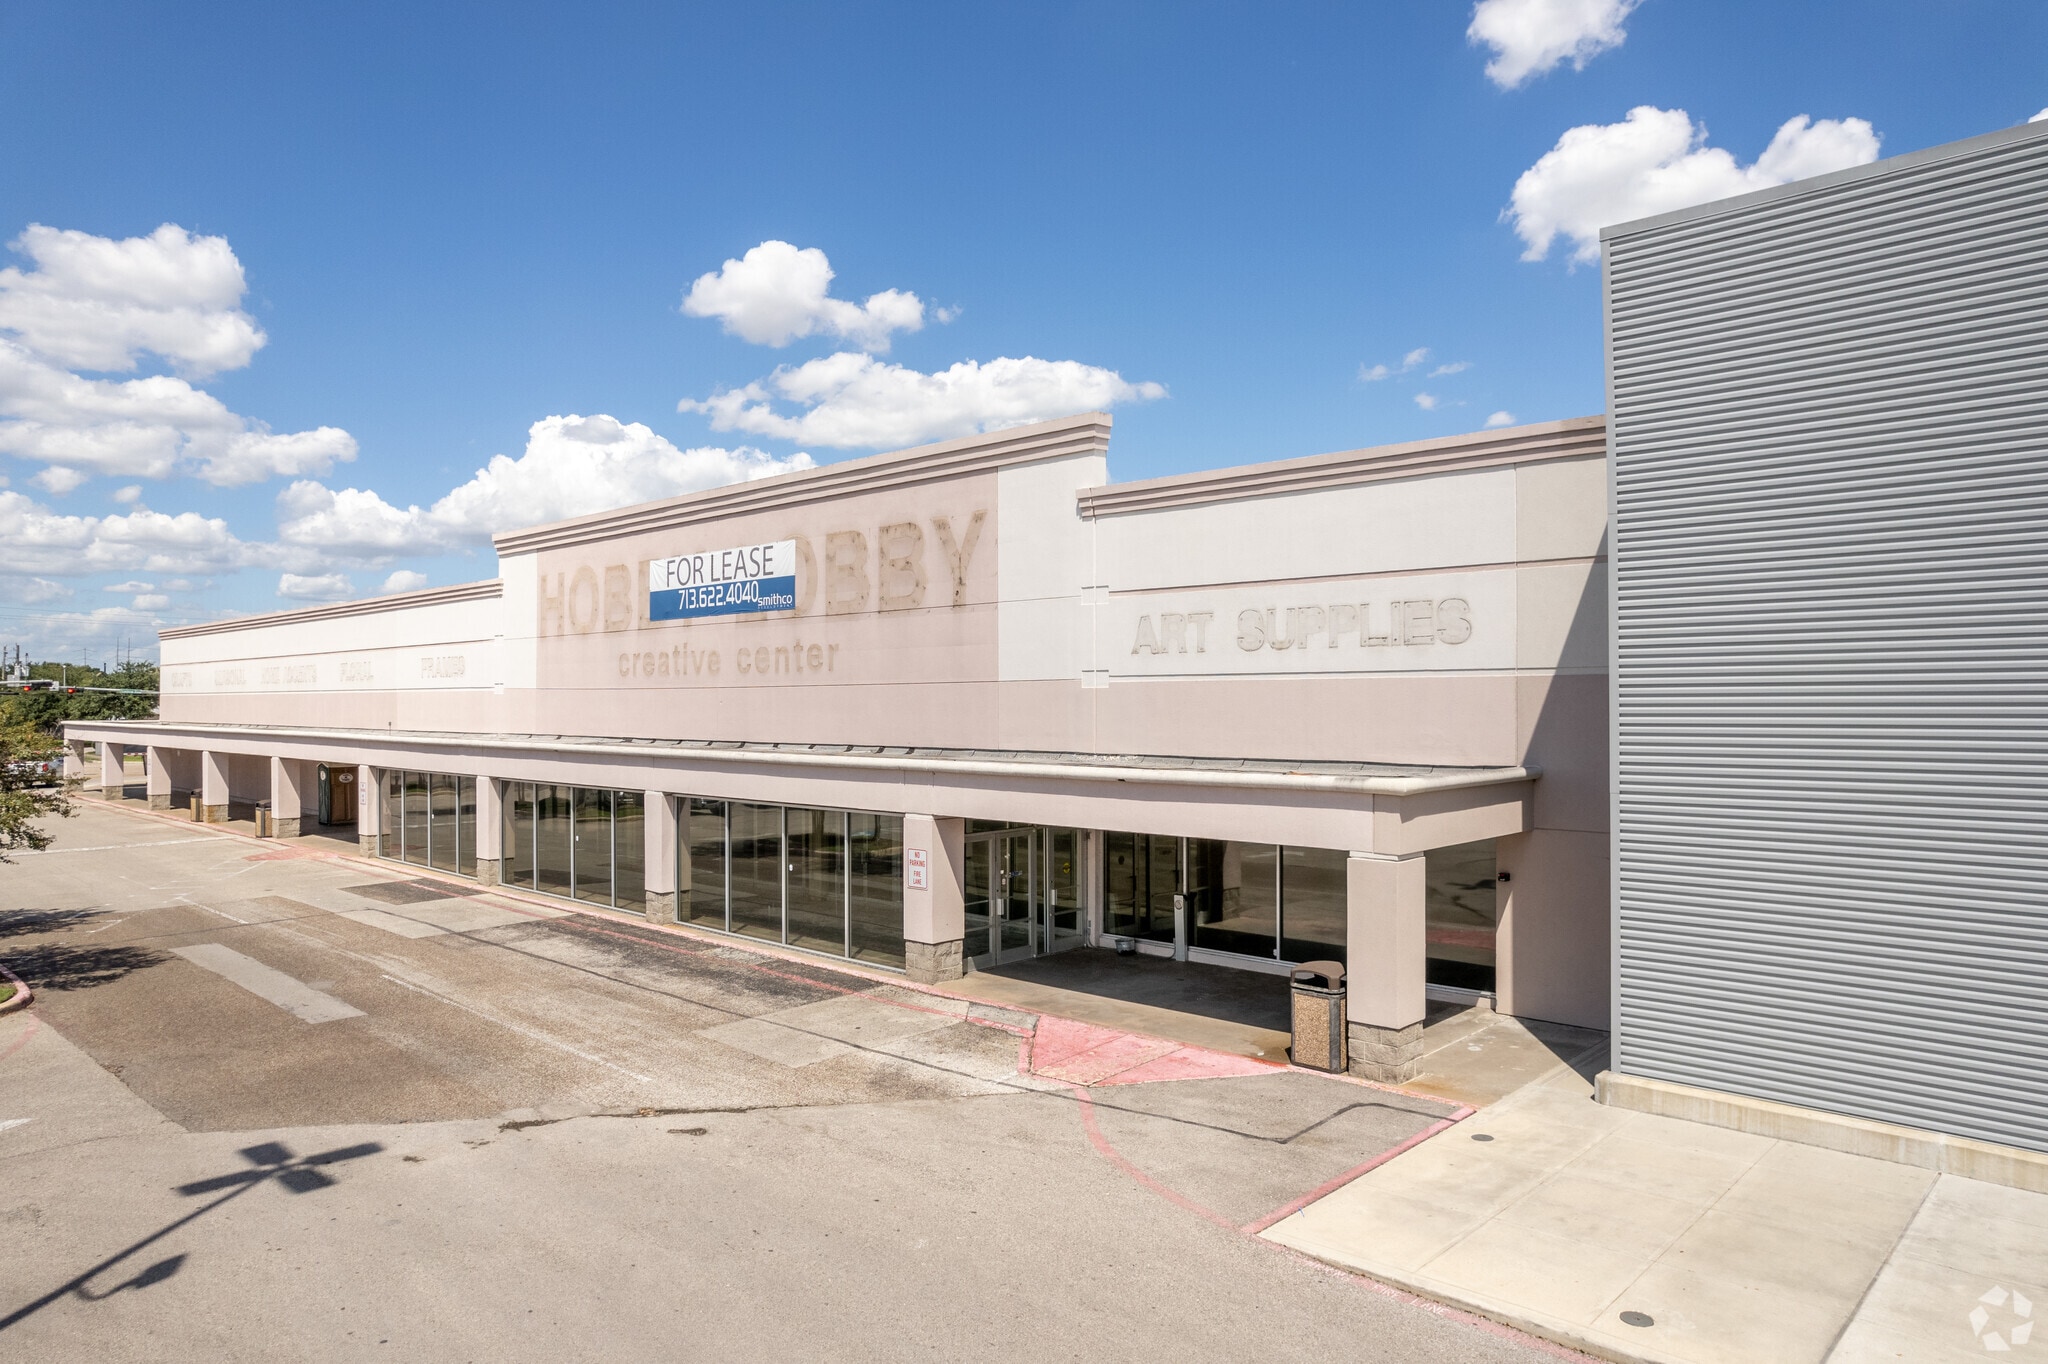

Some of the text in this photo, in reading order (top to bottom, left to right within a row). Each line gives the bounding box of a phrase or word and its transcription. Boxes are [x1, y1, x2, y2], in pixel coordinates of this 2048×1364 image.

[667, 545, 774, 588] FOR LEASE
[678, 580, 759, 611] 713.622.4040
[758, 593, 793, 607] smithco
[1130, 598, 1472, 655] ART SUPPLIES
[618, 639, 840, 678] creative center
